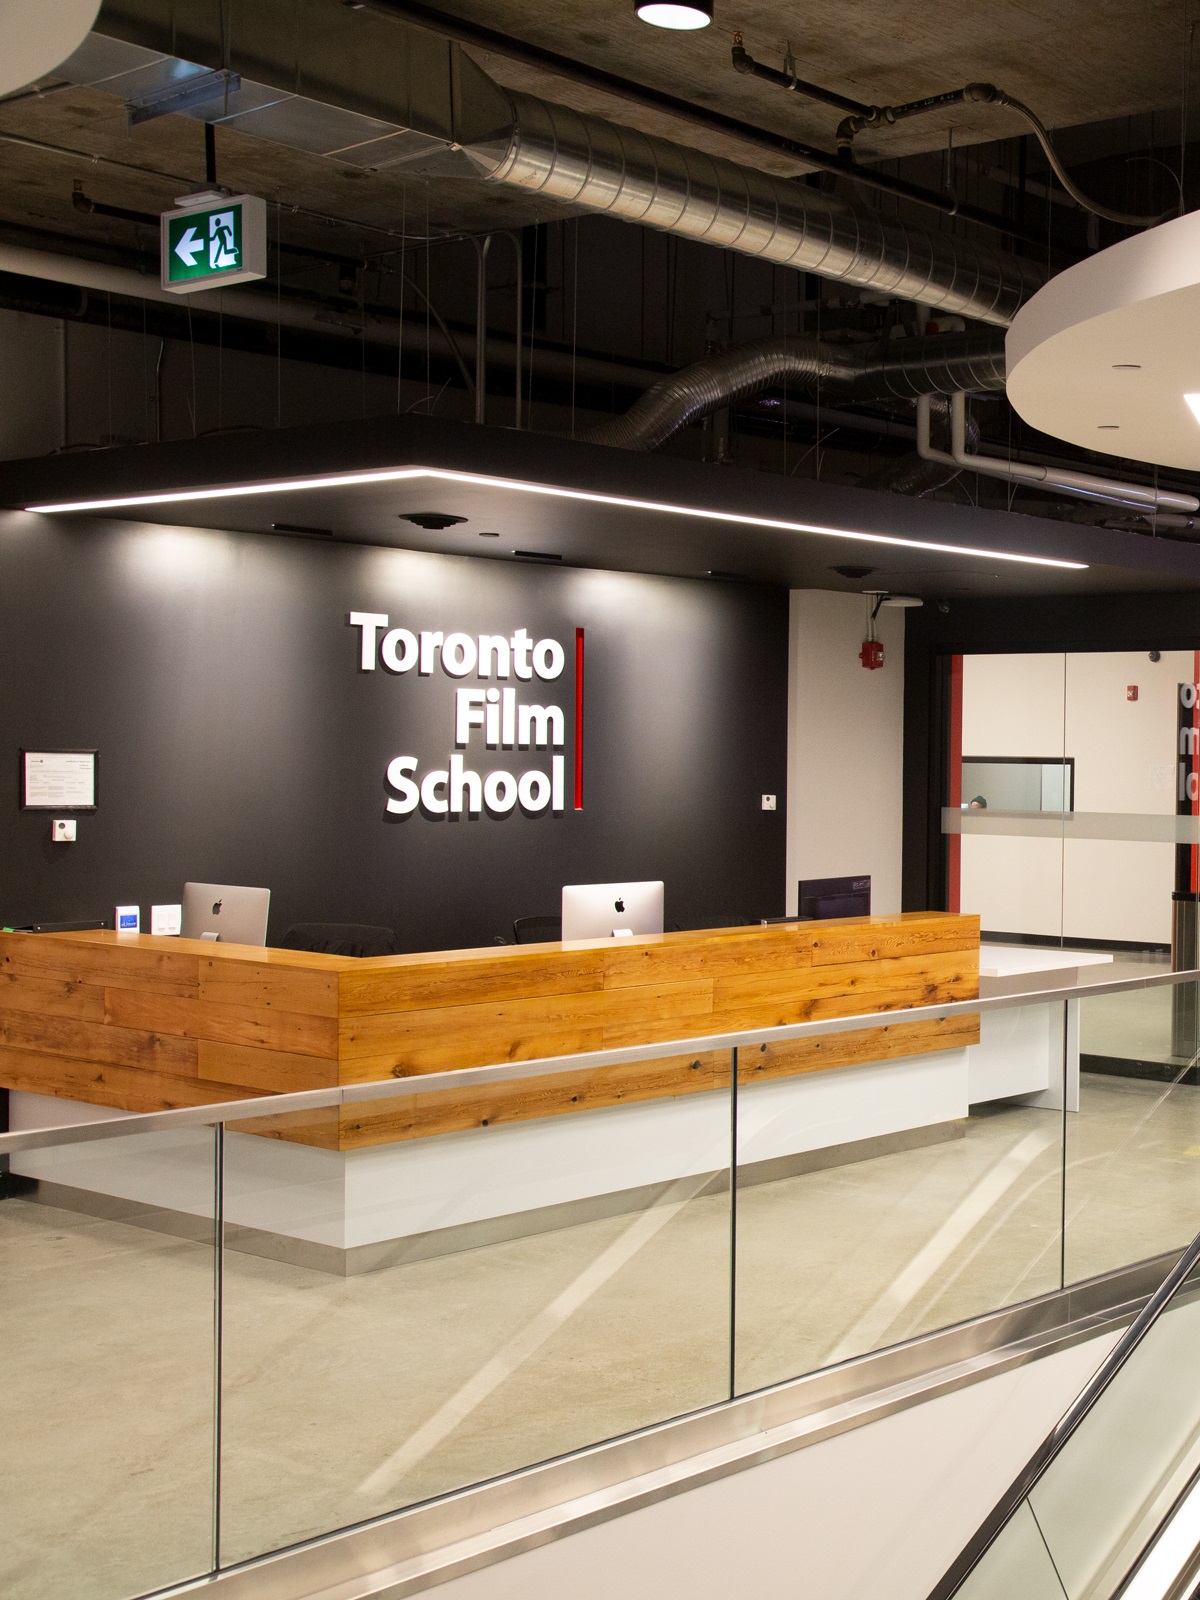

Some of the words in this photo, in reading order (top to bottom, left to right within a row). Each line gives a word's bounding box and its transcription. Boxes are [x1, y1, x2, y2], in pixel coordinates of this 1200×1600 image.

[349, 611, 565, 680] Toronto
[456, 687, 565, 746] Film
[386, 754, 565, 814] School
